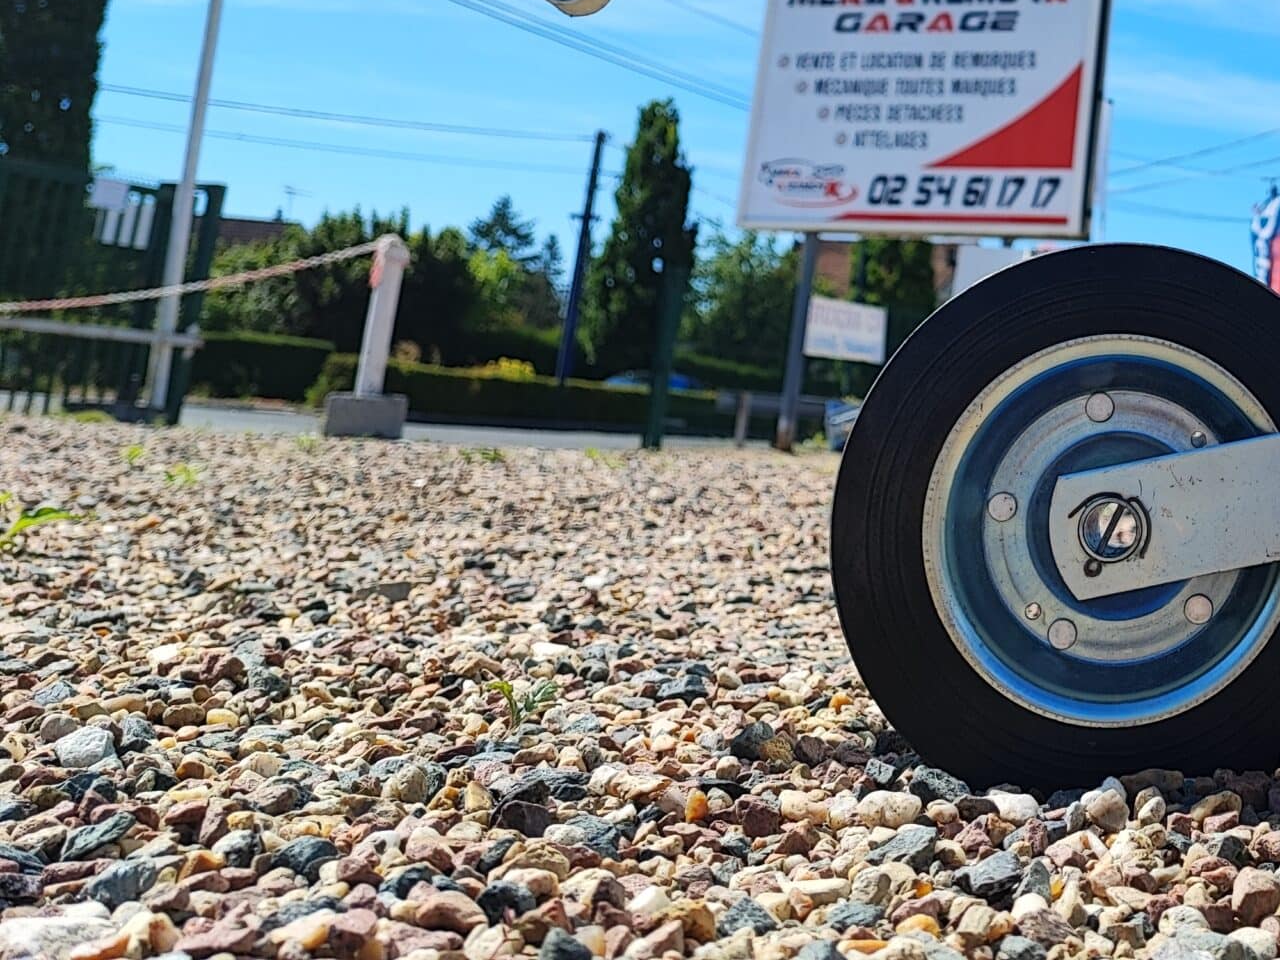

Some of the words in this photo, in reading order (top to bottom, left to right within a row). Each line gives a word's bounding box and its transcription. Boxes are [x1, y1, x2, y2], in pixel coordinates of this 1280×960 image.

[834, 10, 1021, 33] GARAGE
[795, 53, 835, 70] VENTE
[840, 52, 857, 70] ET
[861, 52, 923, 70] LOCATION
[929, 52, 946, 69] DE
[952, 51, 1037, 71] REMORQUES
[896, 78, 944, 96] TOUTES
[952, 78, 1017, 97] MARQUES
[867, 175, 907, 205] 02
[913, 176, 955, 206] 54
[962, 176, 990, 208] 61
[997, 177, 1026, 208] 17
[1031, 177, 1061, 208] 17
